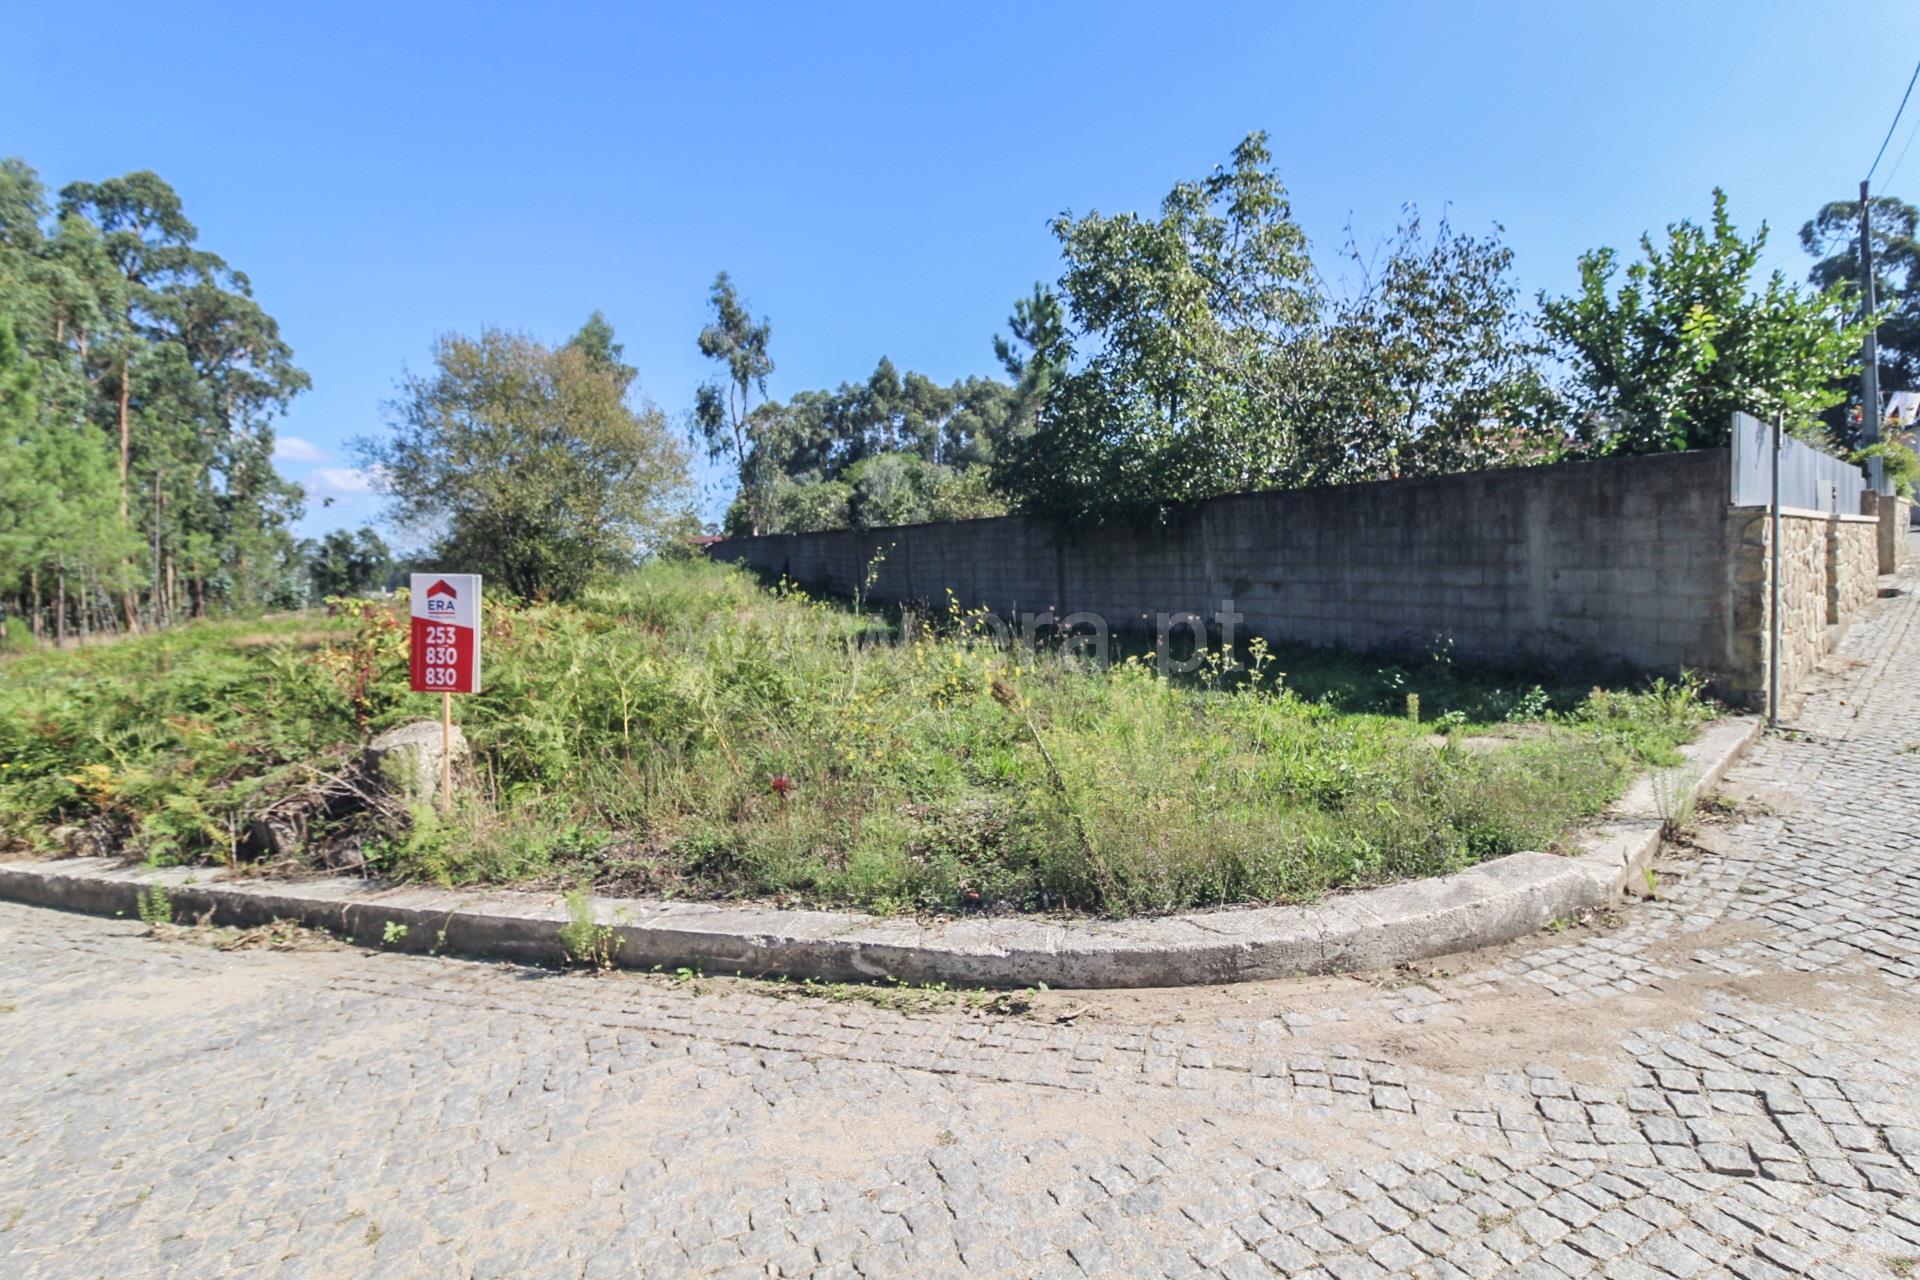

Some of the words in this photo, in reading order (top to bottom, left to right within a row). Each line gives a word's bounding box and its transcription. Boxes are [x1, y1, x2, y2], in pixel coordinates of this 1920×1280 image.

[428, 600, 456, 611] ERA
[426, 627, 456, 644] 253
[426, 648, 457, 665] 830
[425, 668, 457, 686] 830
